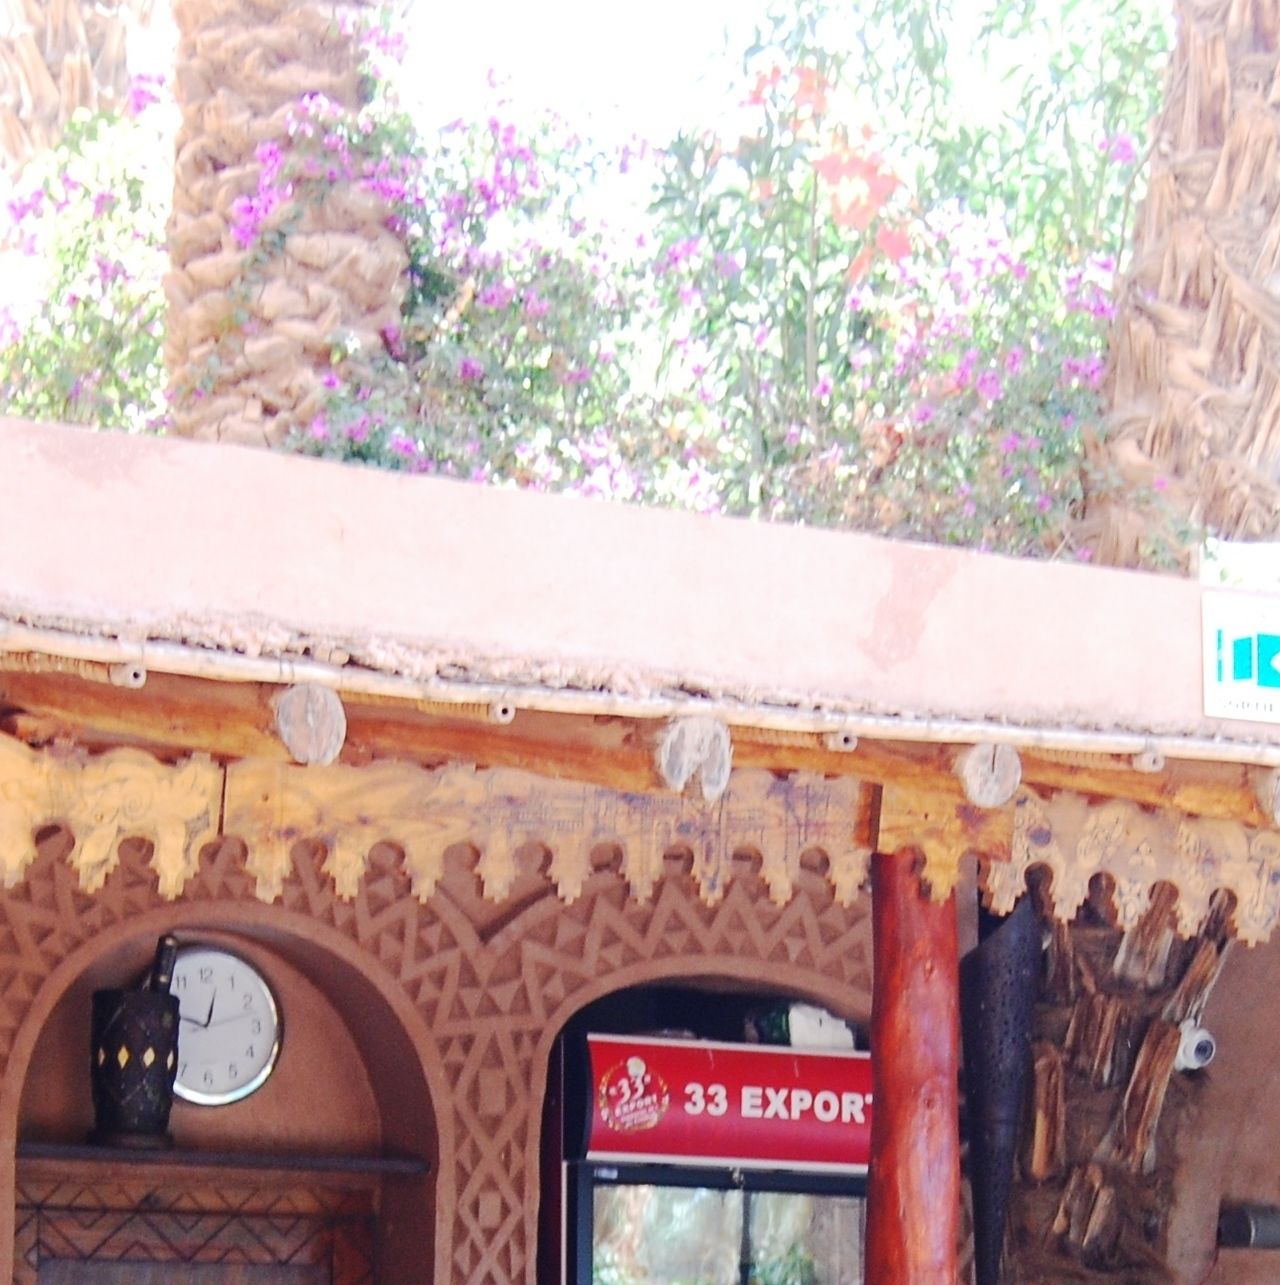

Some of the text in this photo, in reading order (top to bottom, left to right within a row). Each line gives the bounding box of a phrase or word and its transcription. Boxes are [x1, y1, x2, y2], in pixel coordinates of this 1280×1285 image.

[199, 967, 214, 982] 12
[176, 975, 188, 990] 11
[242, 993, 253, 1010] 2
[251, 1018, 261, 1035] 3
[245, 1045, 254, 1058] 4
[202, 1071, 214, 1086] 6
[228, 1063, 238, 1079] 5
[683, 1082, 728, 1116] 33
